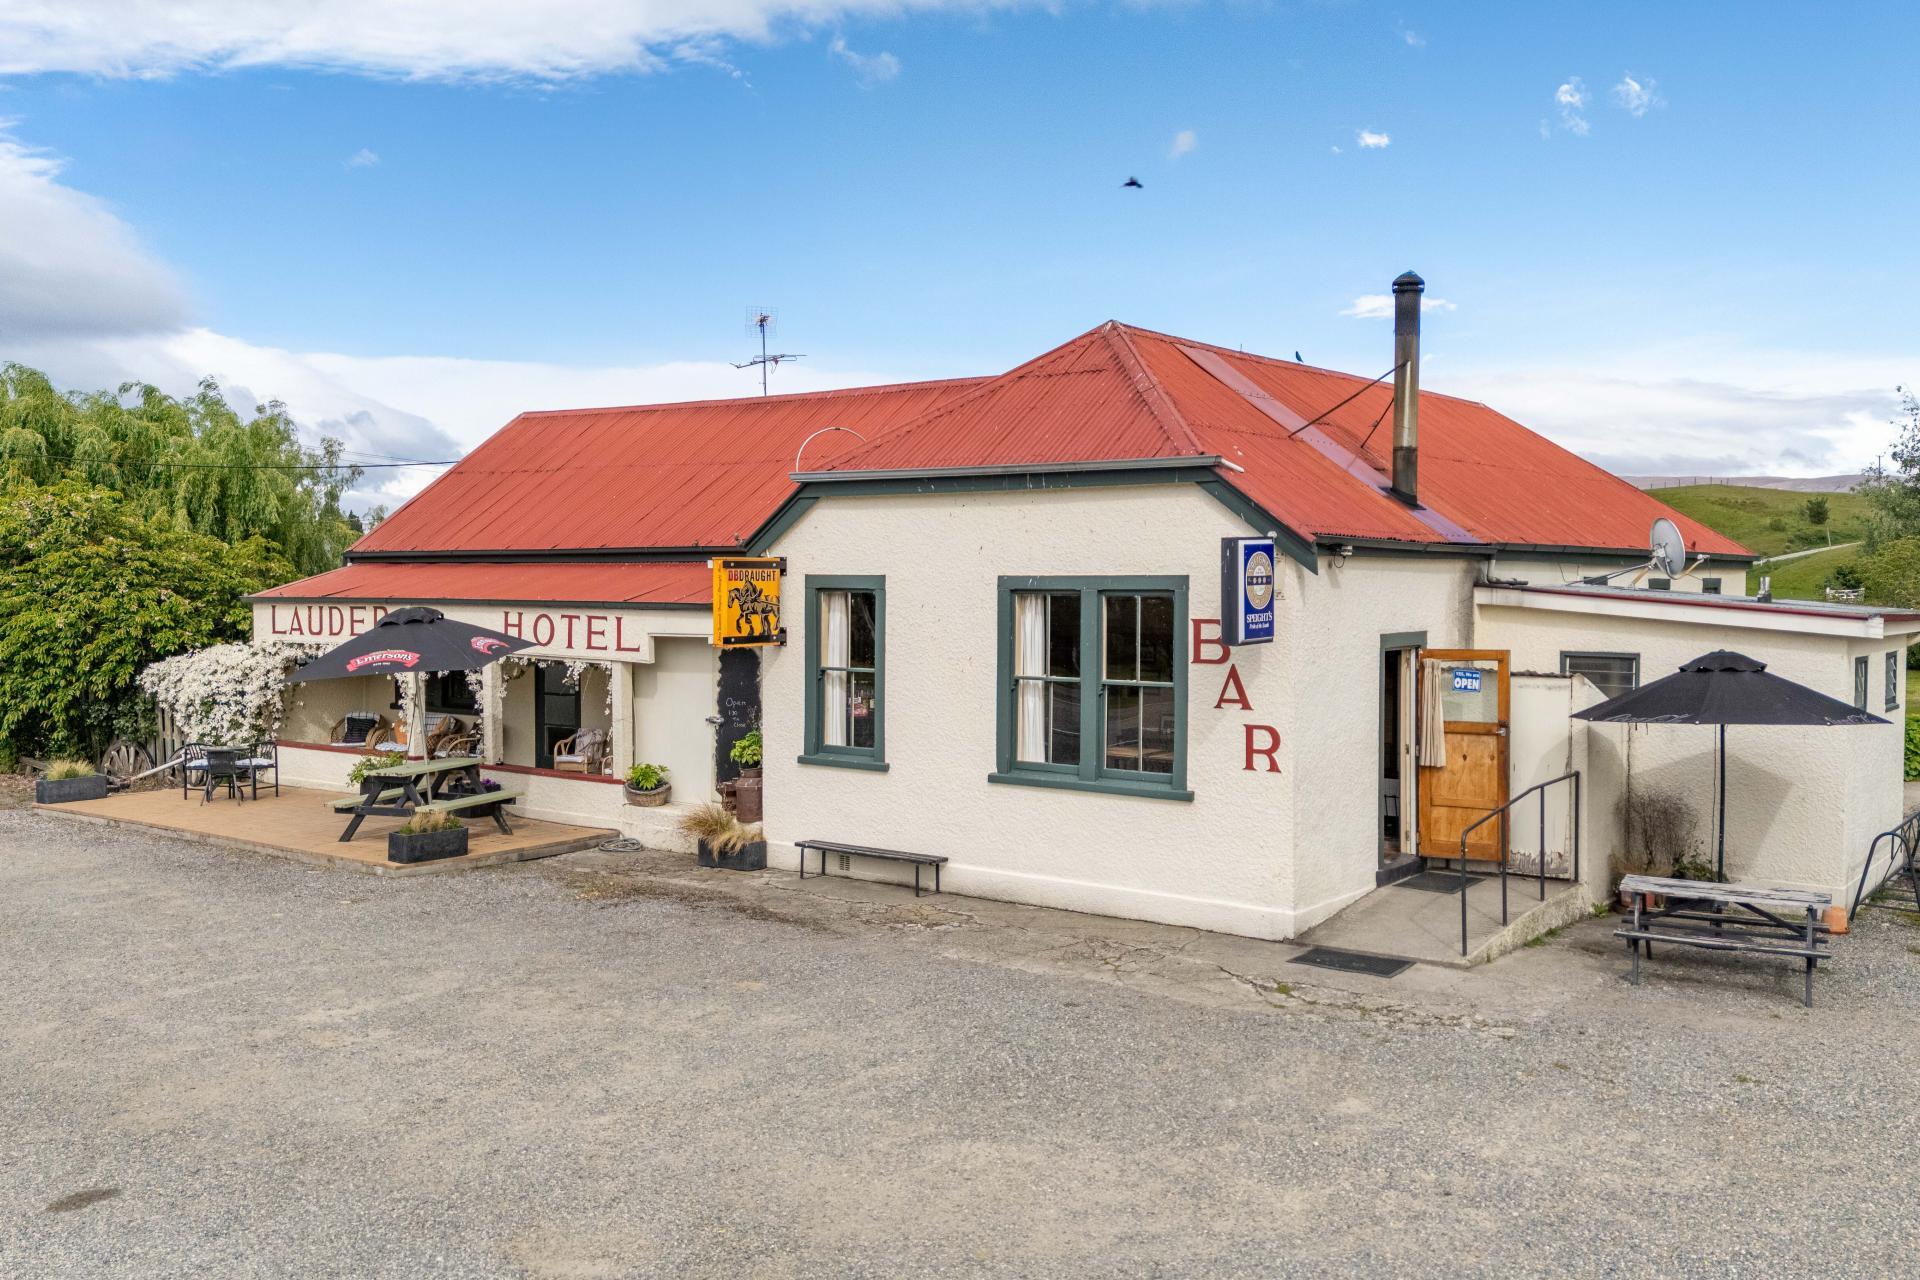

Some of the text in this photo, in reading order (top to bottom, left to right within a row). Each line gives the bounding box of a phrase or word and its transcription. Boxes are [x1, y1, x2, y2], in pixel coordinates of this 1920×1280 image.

[503, 610, 641, 653] HOTEL
[1190, 618, 1282, 773] BAR
[1454, 677, 1478, 689] OPEN
